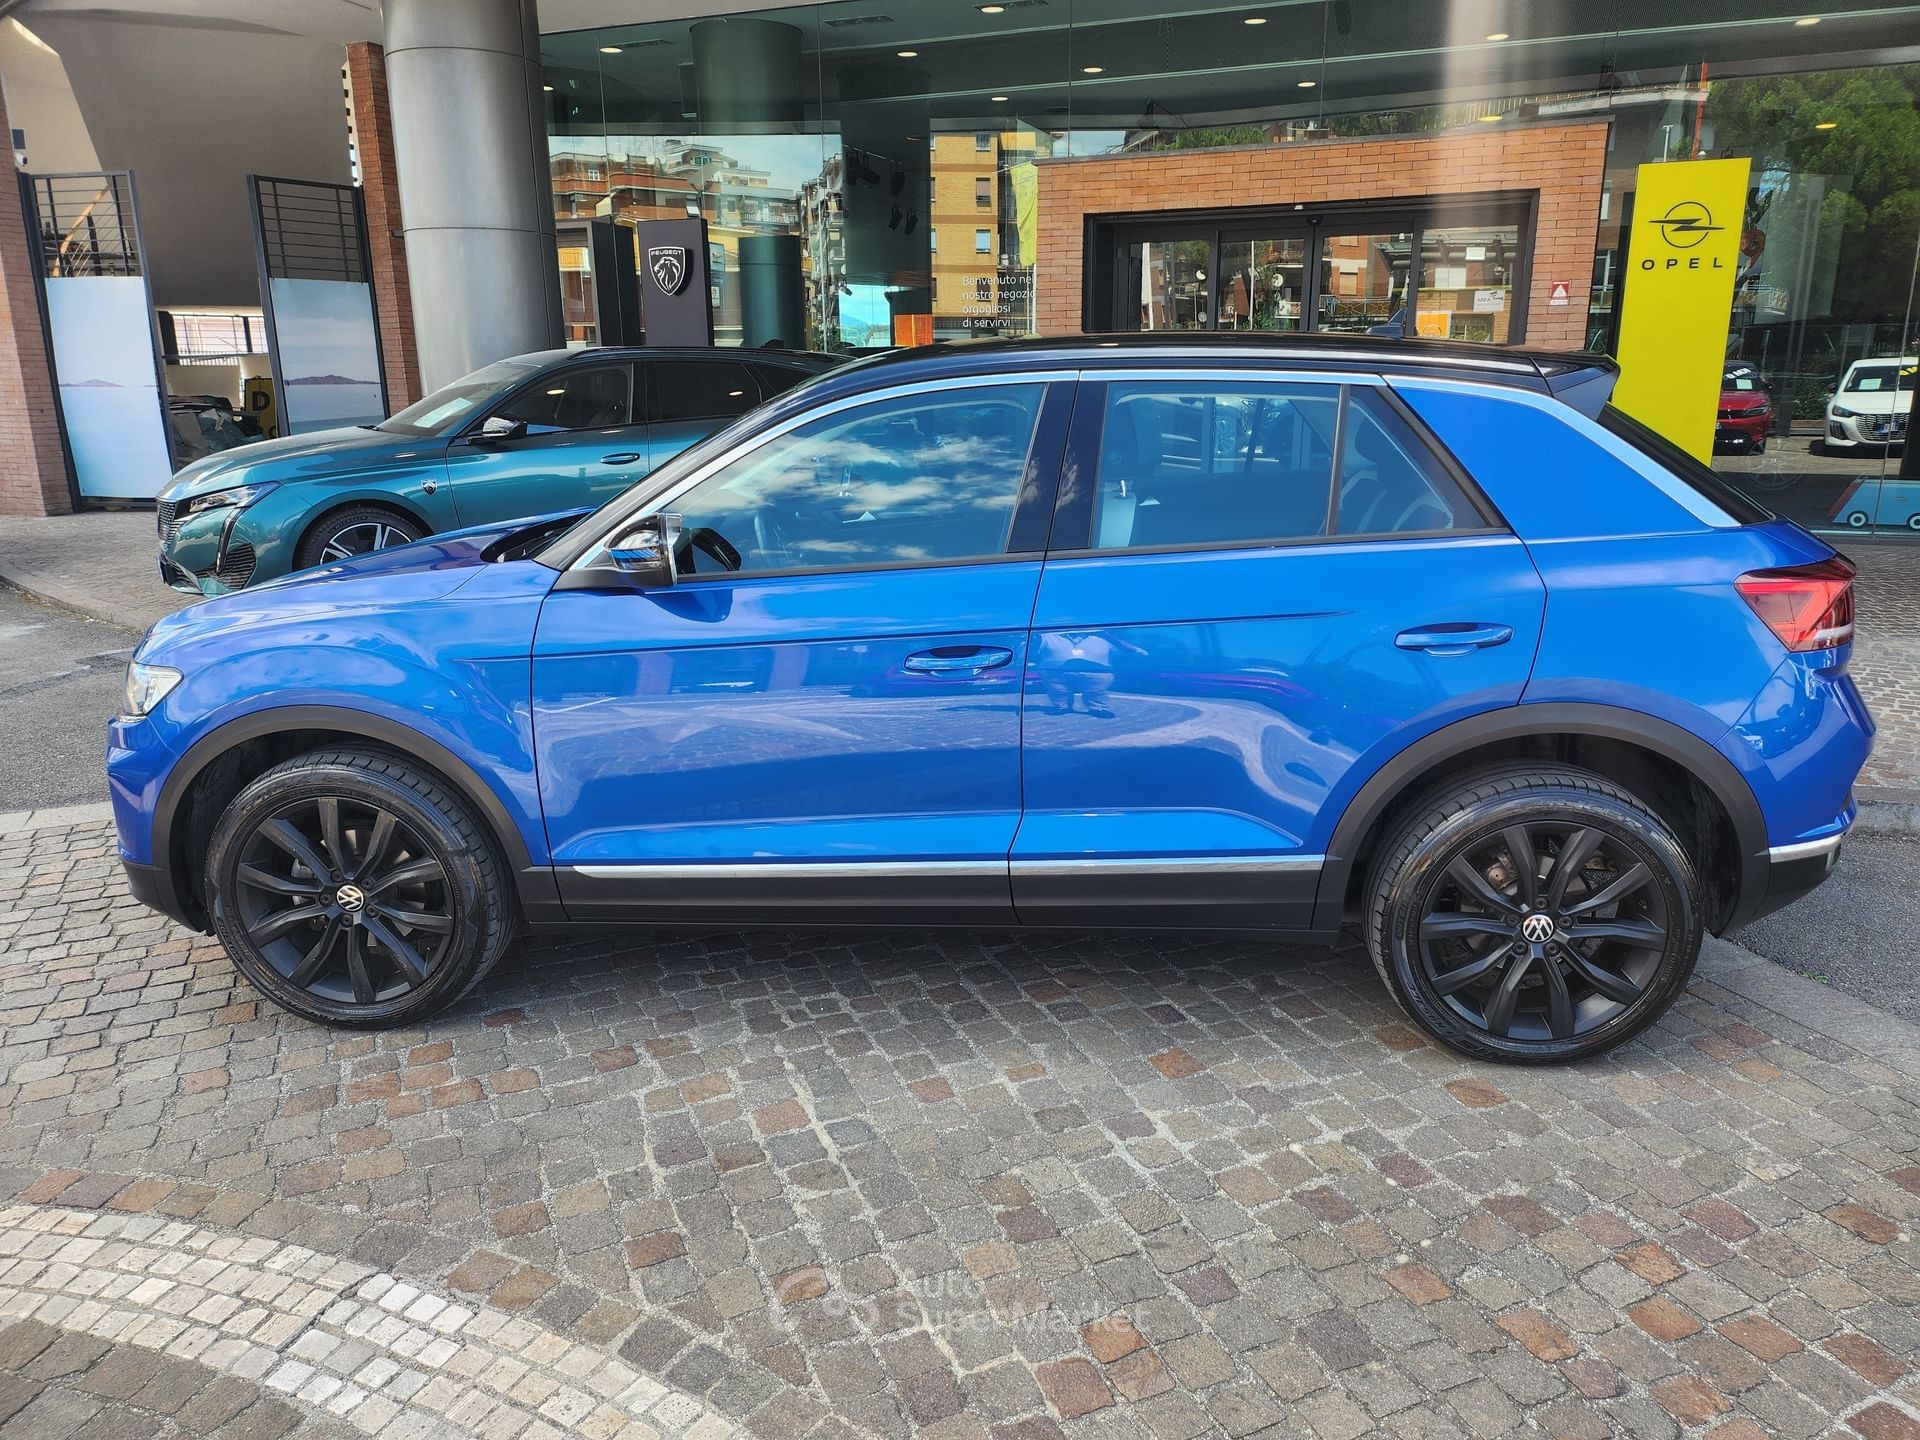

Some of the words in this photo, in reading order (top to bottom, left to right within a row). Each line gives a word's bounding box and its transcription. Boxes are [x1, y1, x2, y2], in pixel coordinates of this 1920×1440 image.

[1641, 257, 1724, 271] OPEL
[962, 275, 1016, 286] Benvenuto
[962, 289, 995, 300] nostro
[962, 303, 1011, 316] orgogliosi
[962, 317, 972, 328] di
[974, 317, 1011, 328] servirvi
